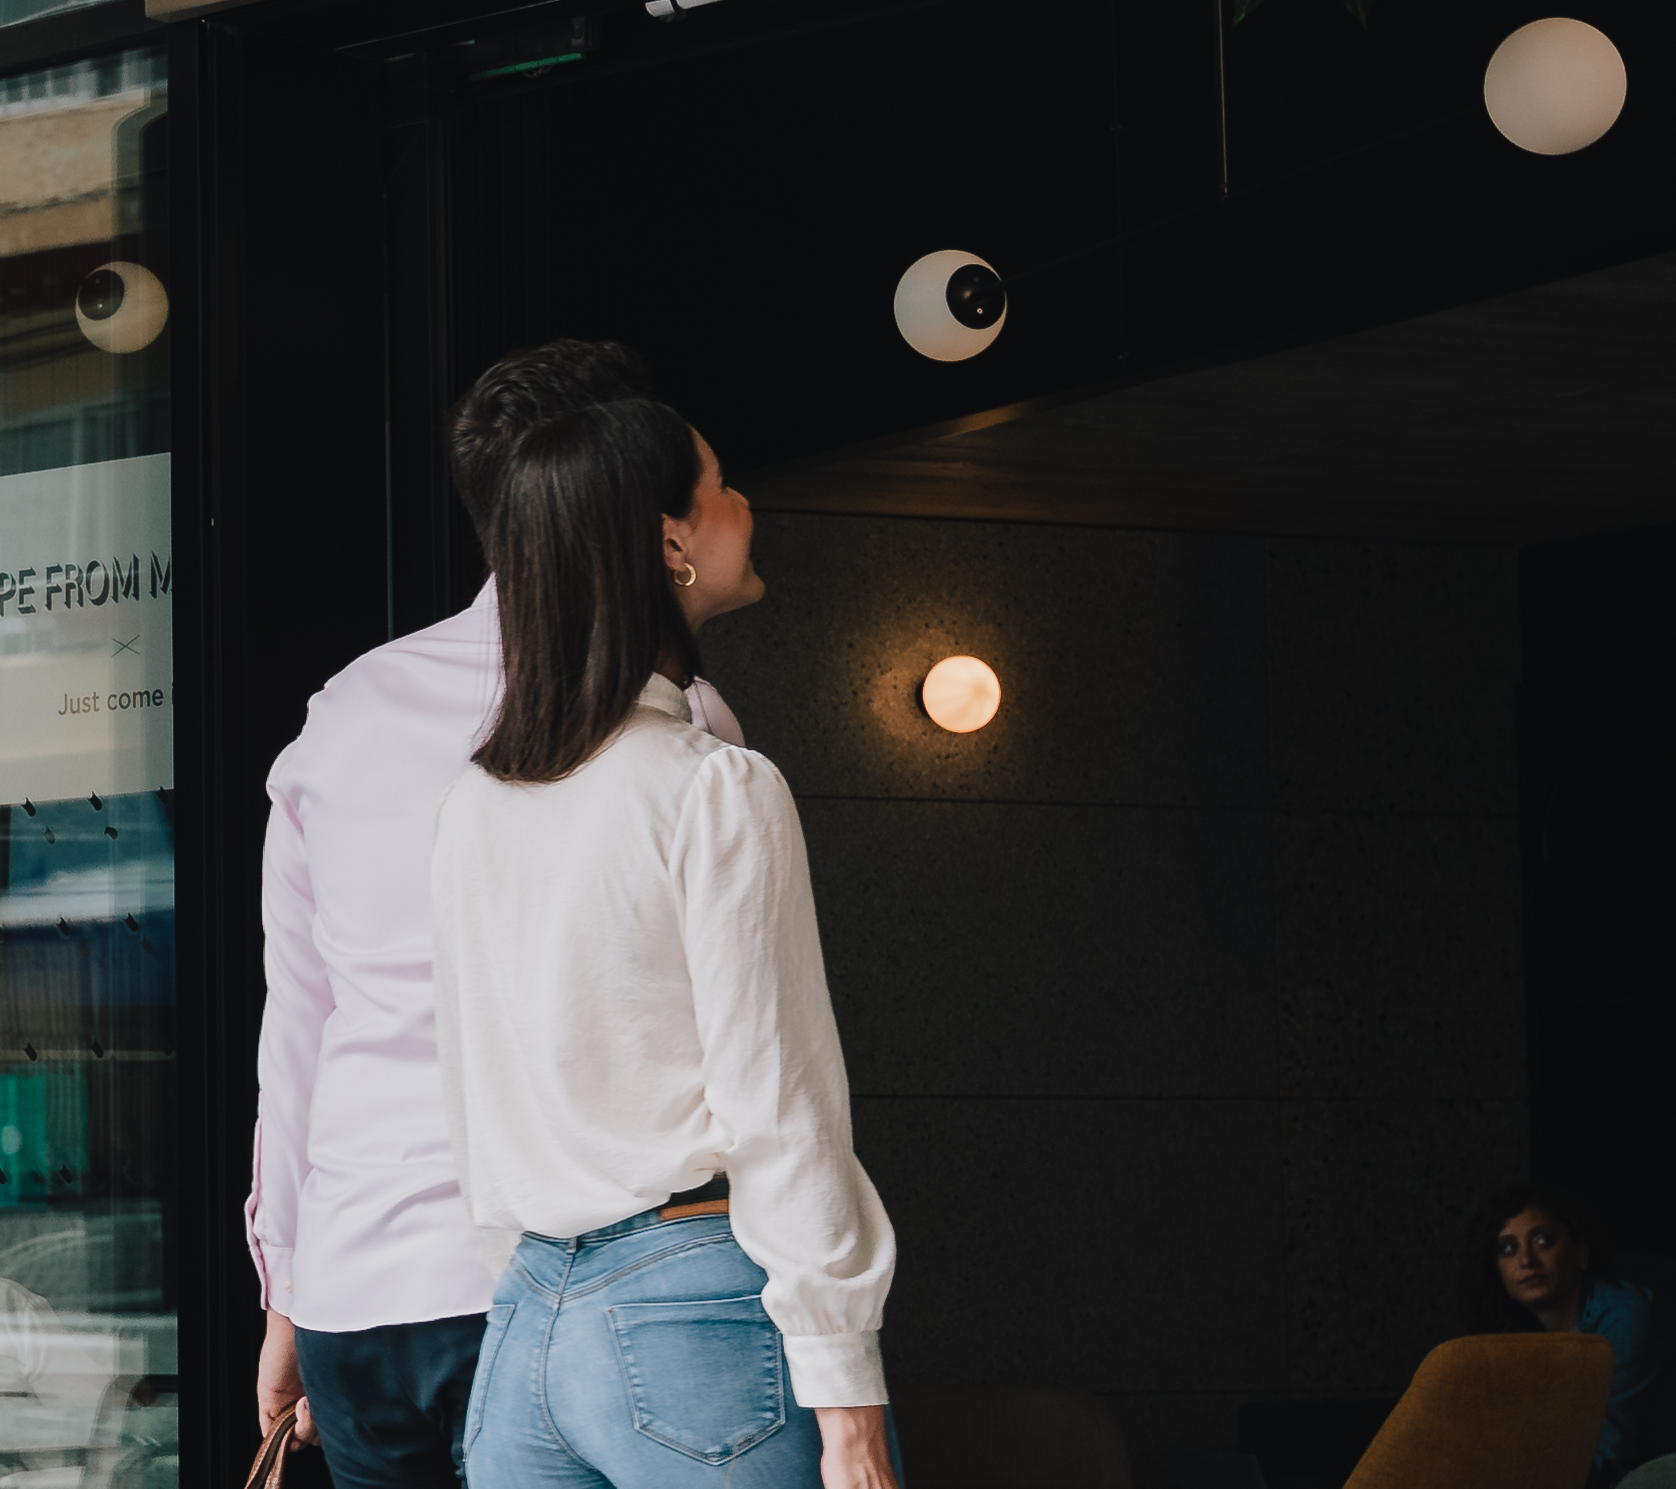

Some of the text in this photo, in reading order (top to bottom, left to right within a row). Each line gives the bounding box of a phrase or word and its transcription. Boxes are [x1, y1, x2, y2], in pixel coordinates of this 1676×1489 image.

[44, 553, 141, 612] FROM
[57, 690, 100, 717] Just
[106, 687, 165, 712] come
